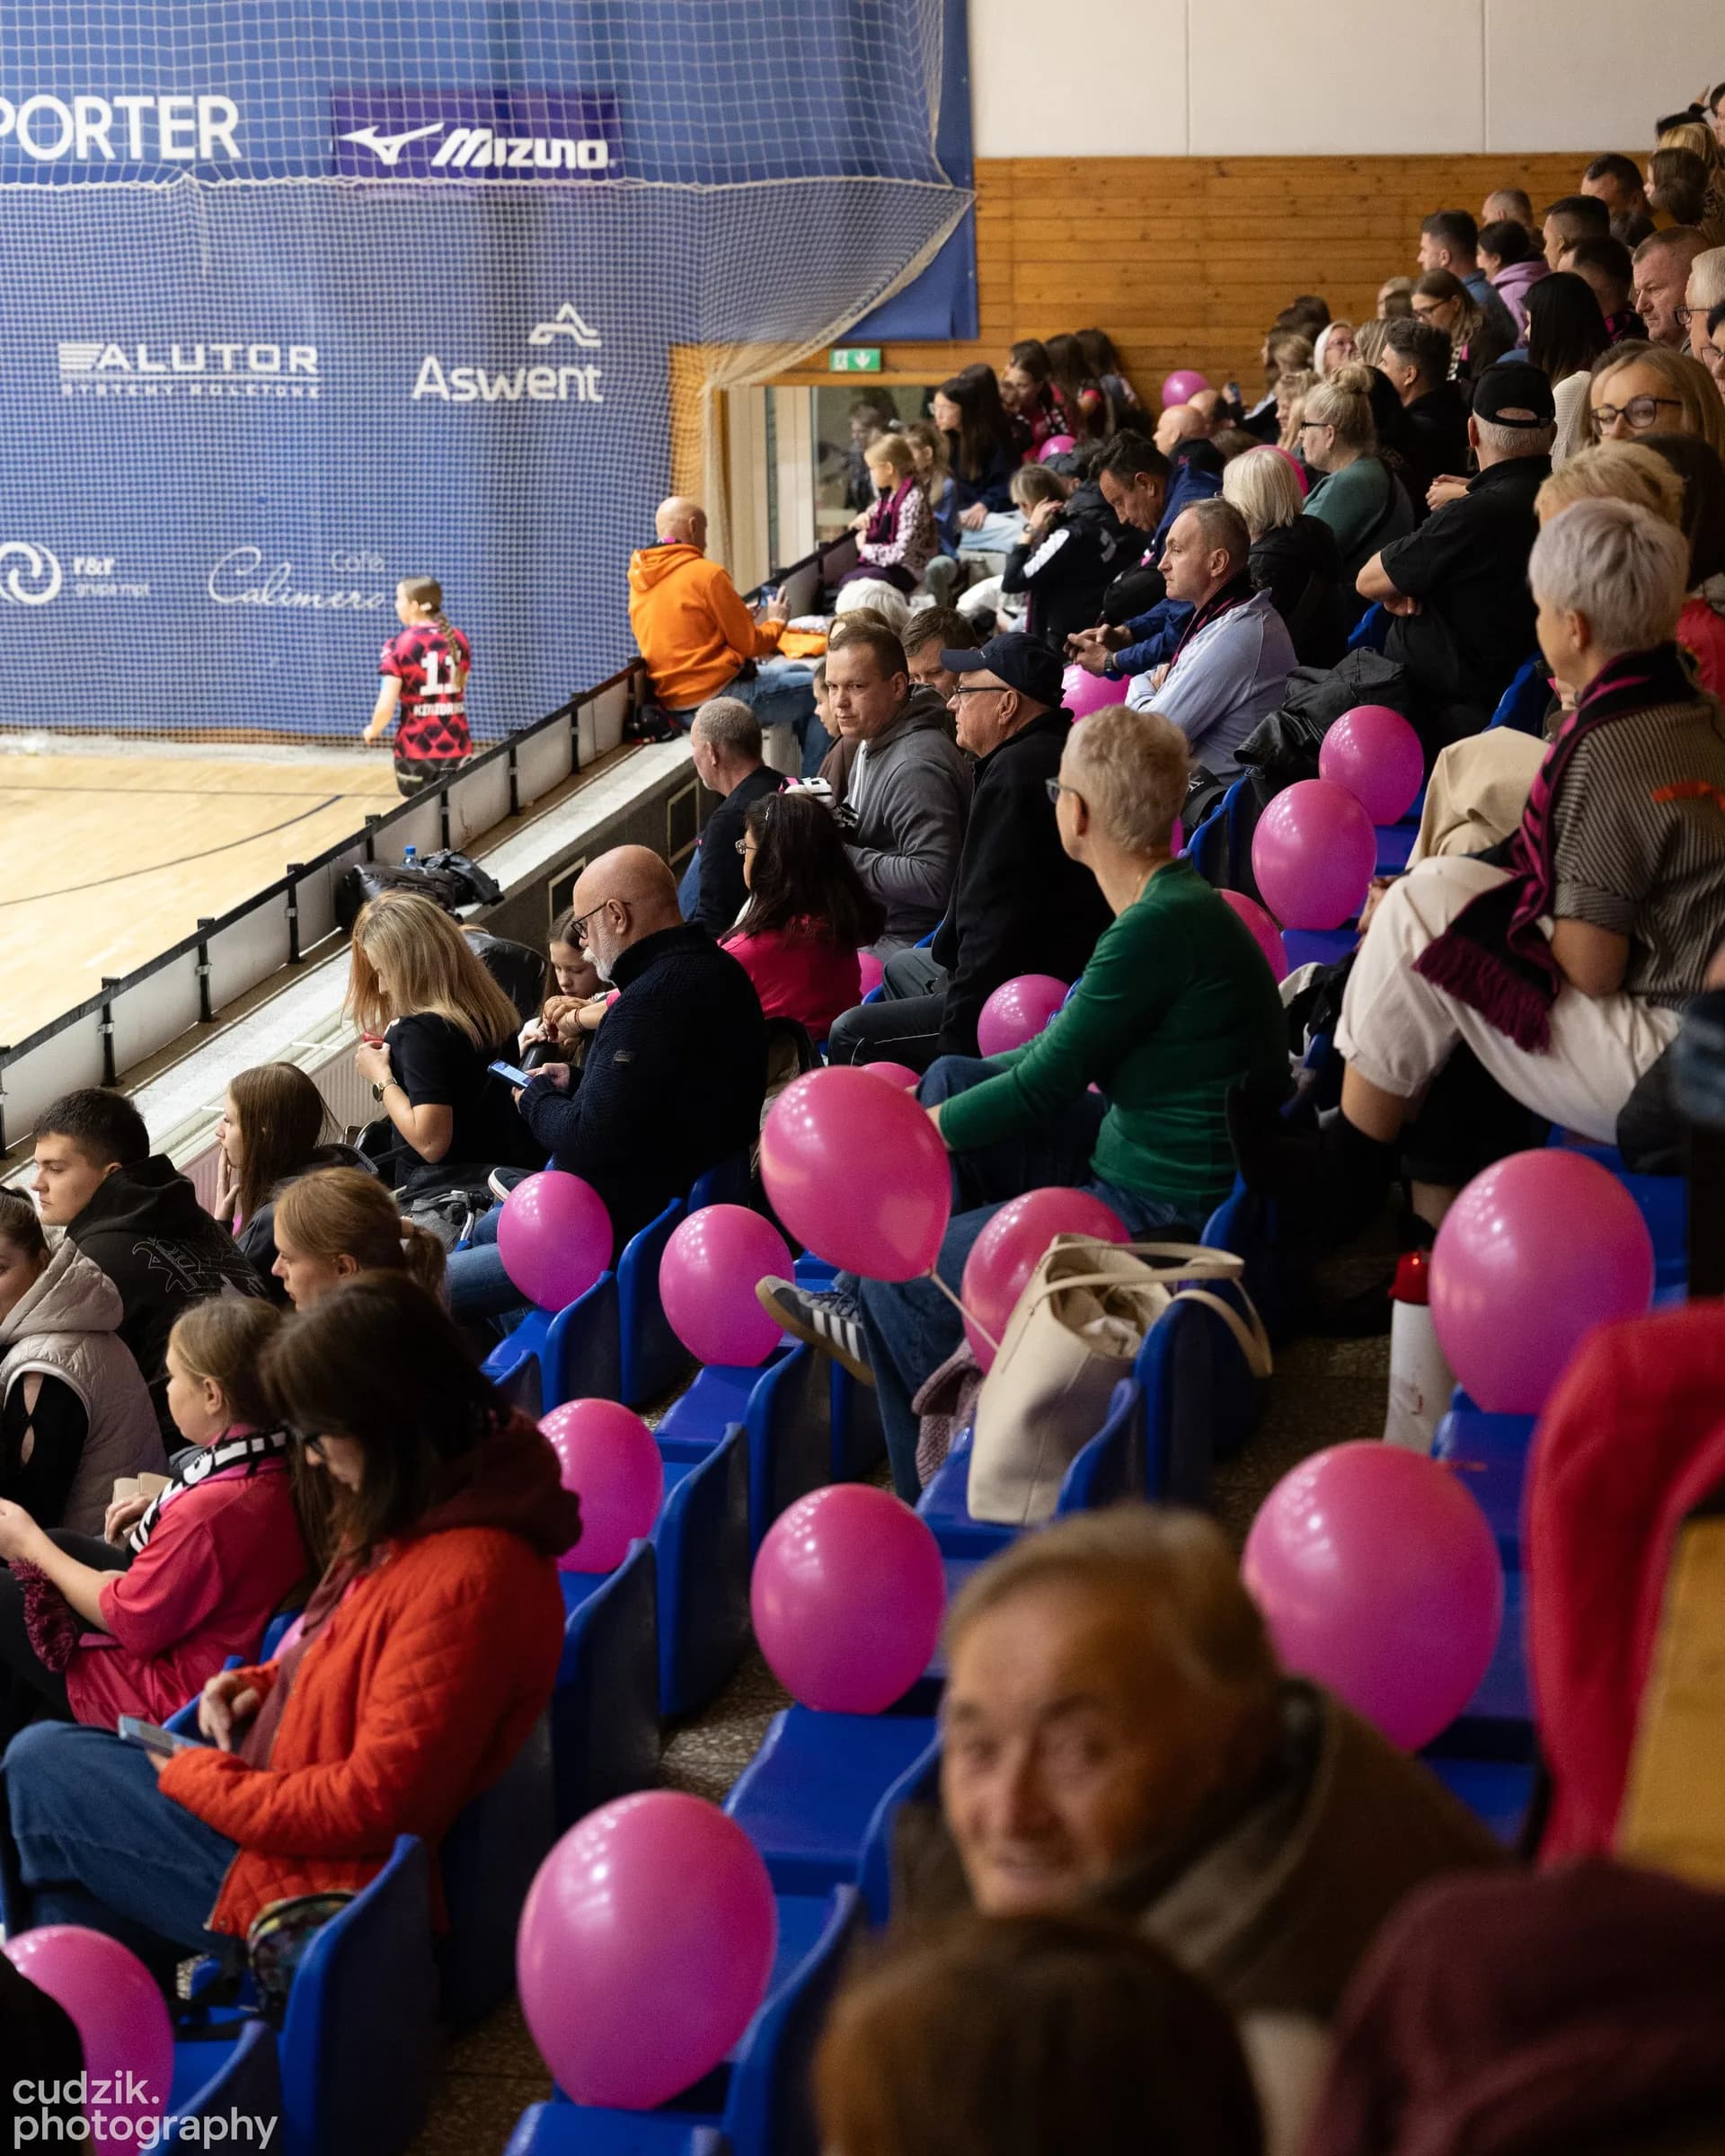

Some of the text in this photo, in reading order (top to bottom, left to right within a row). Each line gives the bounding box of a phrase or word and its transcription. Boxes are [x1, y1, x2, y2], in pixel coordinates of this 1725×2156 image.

[95, 342, 318, 374] ALUTOR
[411, 355, 604, 402] Aswent
[420, 649, 462, 697] 11
